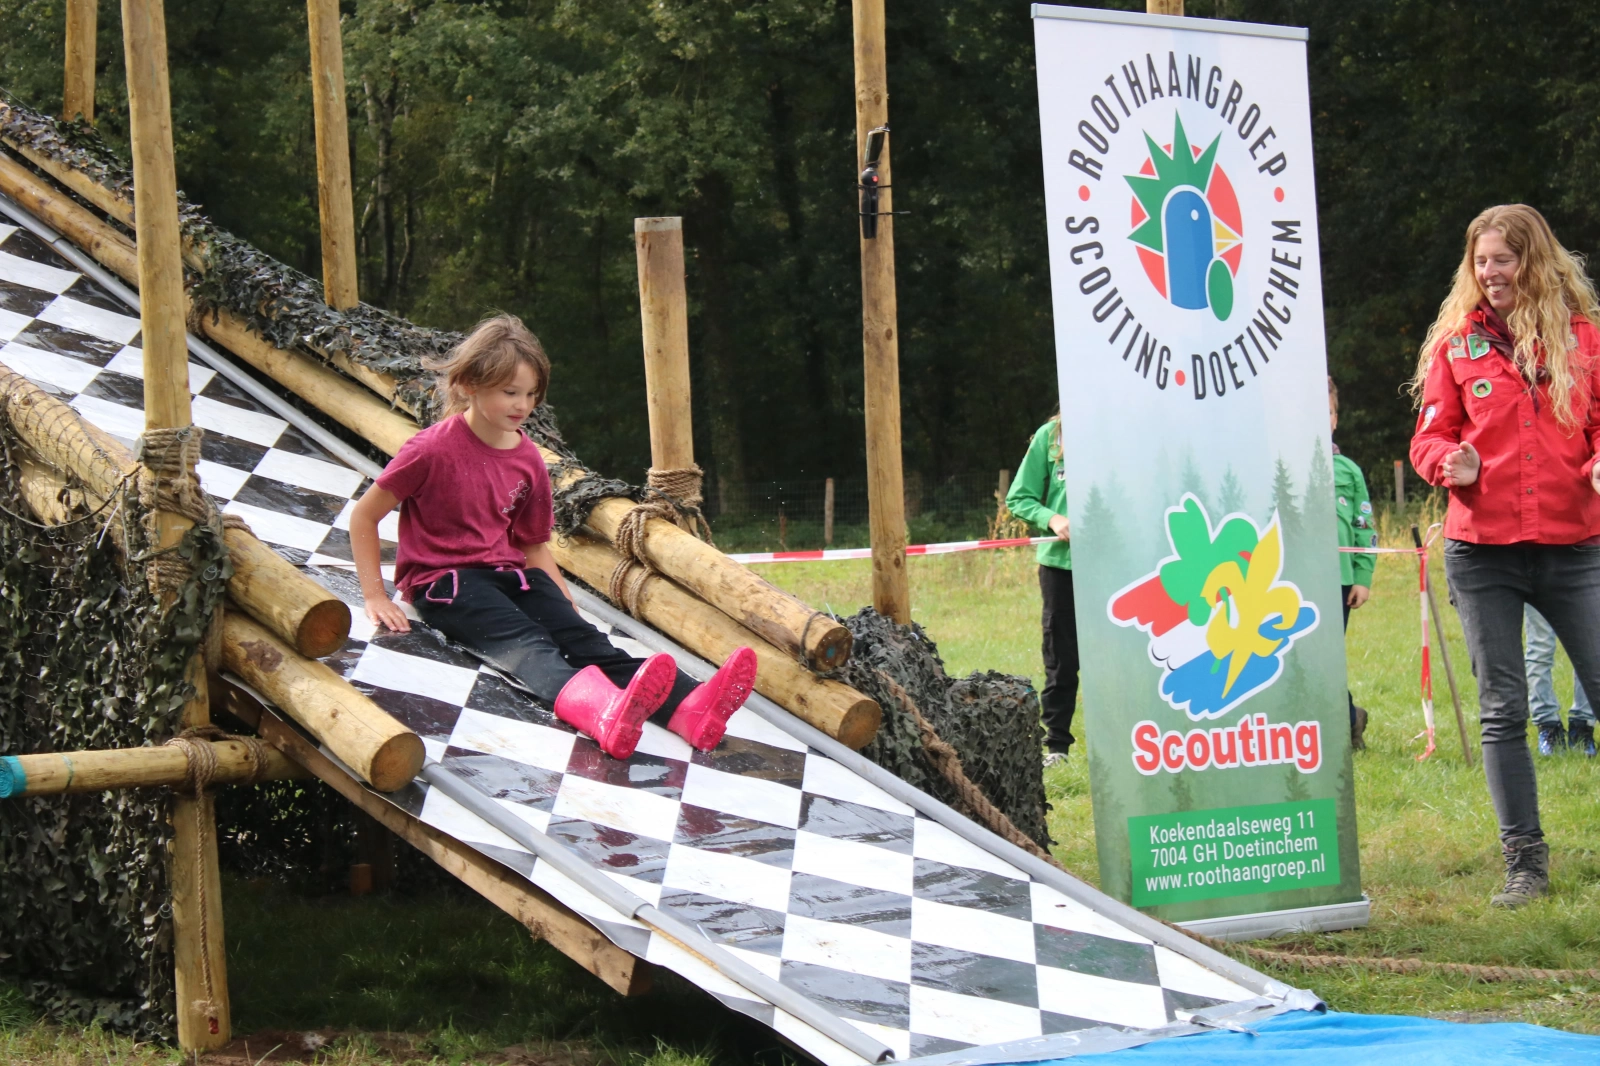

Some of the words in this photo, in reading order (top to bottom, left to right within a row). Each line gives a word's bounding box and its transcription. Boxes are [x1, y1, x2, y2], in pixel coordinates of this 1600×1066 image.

[1068, 51, 1287, 180] ROOTHAANGROEP
[1065, 216, 1171, 390] SCOUTING
[1191, 220, 1302, 400] DOETINCHEM
[1134, 716, 1320, 772] Scouting
[1150, 816, 1292, 845] Koekendaalseweg
[1296, 811, 1315, 829] 11
[1150, 846, 1188, 868] 7004
[1193, 843, 1217, 863] GH
[1223, 833, 1318, 860] Doetinchem
[1145, 853, 1326, 892] www.roothaangroep.nl
